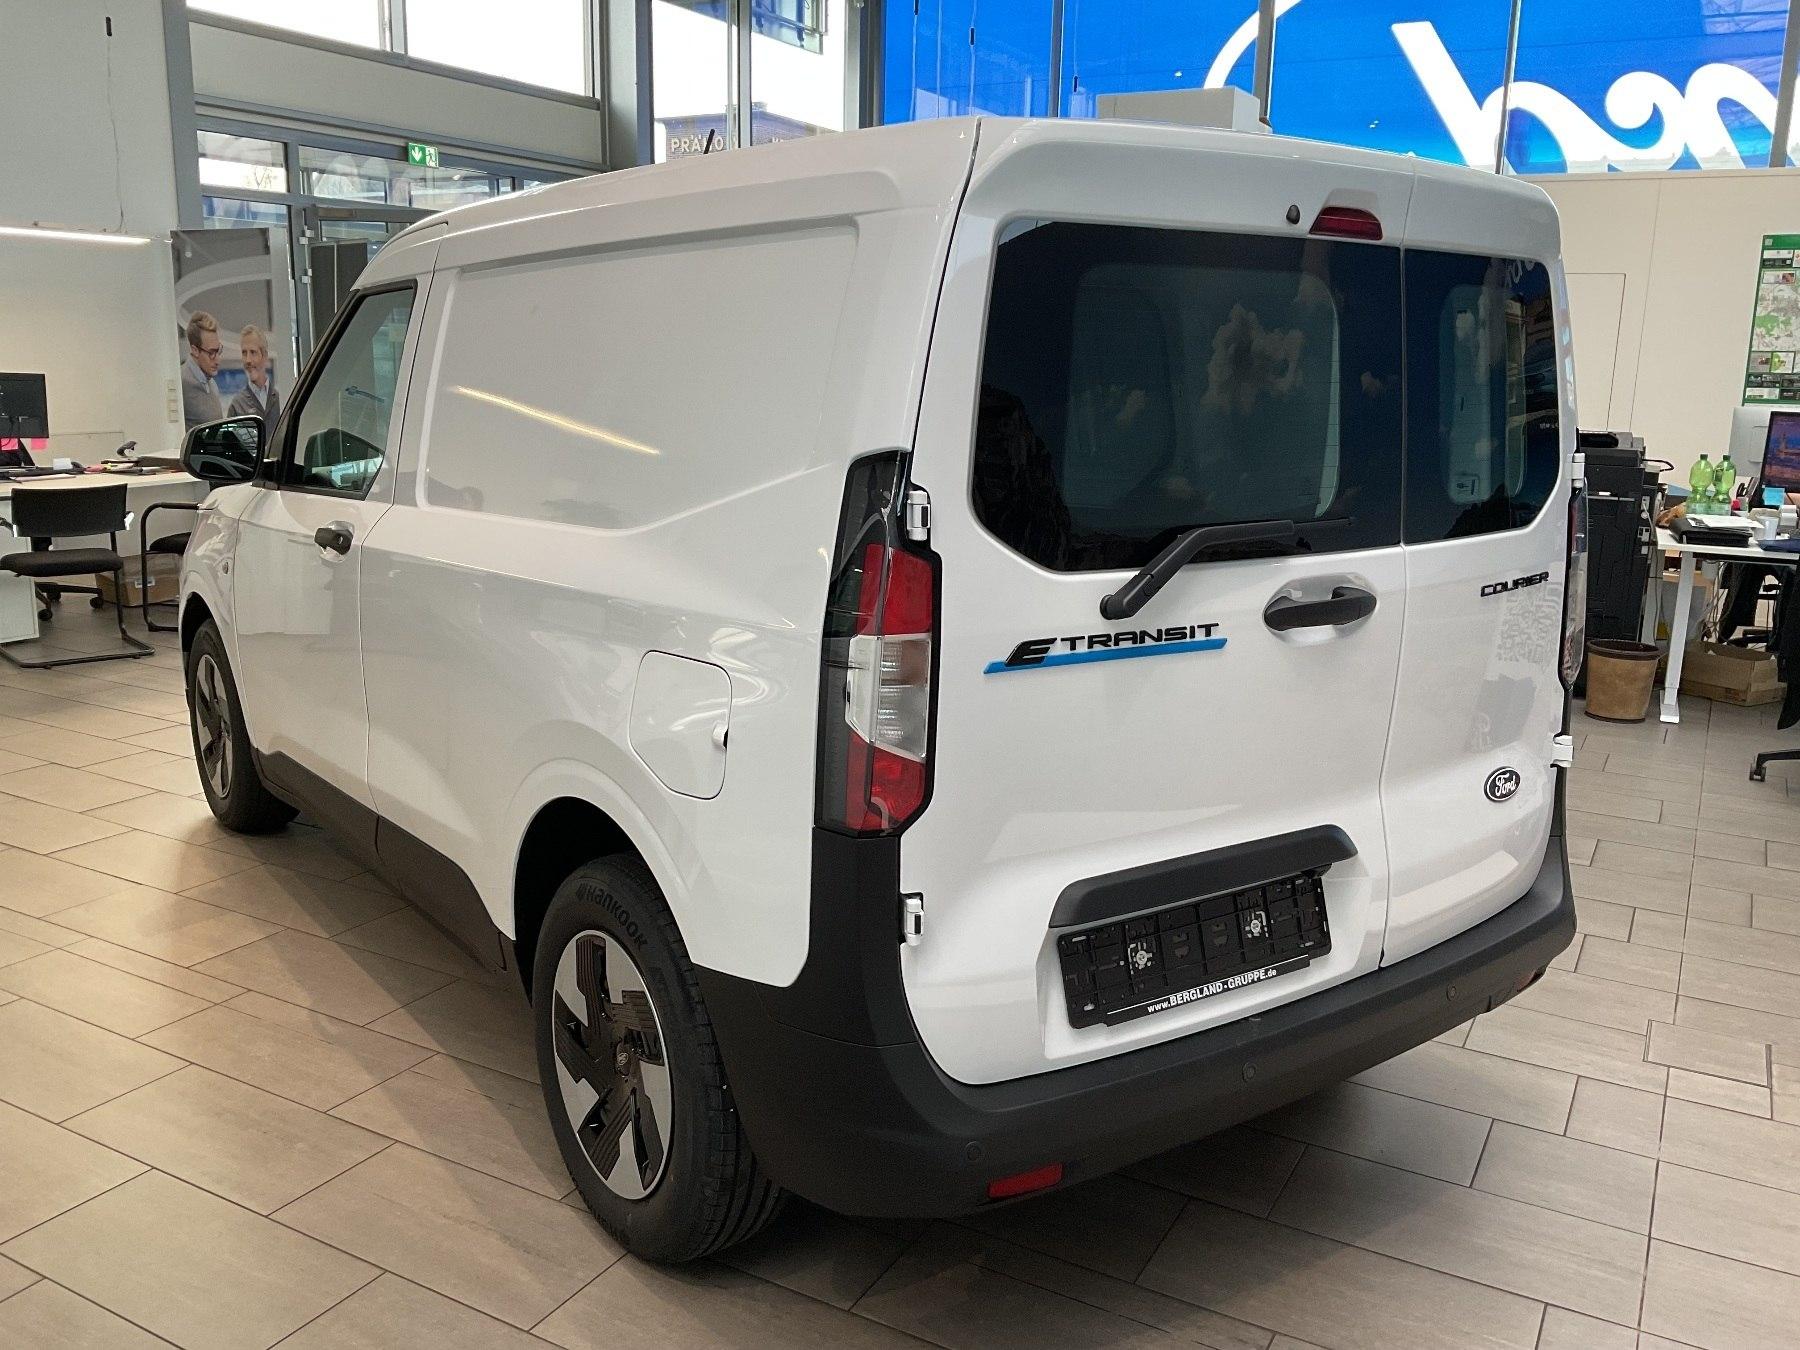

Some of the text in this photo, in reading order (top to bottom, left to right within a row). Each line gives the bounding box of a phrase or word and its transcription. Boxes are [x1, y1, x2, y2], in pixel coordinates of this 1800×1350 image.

[1480, 571, 1549, 597] COURIER
[1060, 622, 1220, 650] TRANSIT
[1494, 772, 1517, 797] Ford
